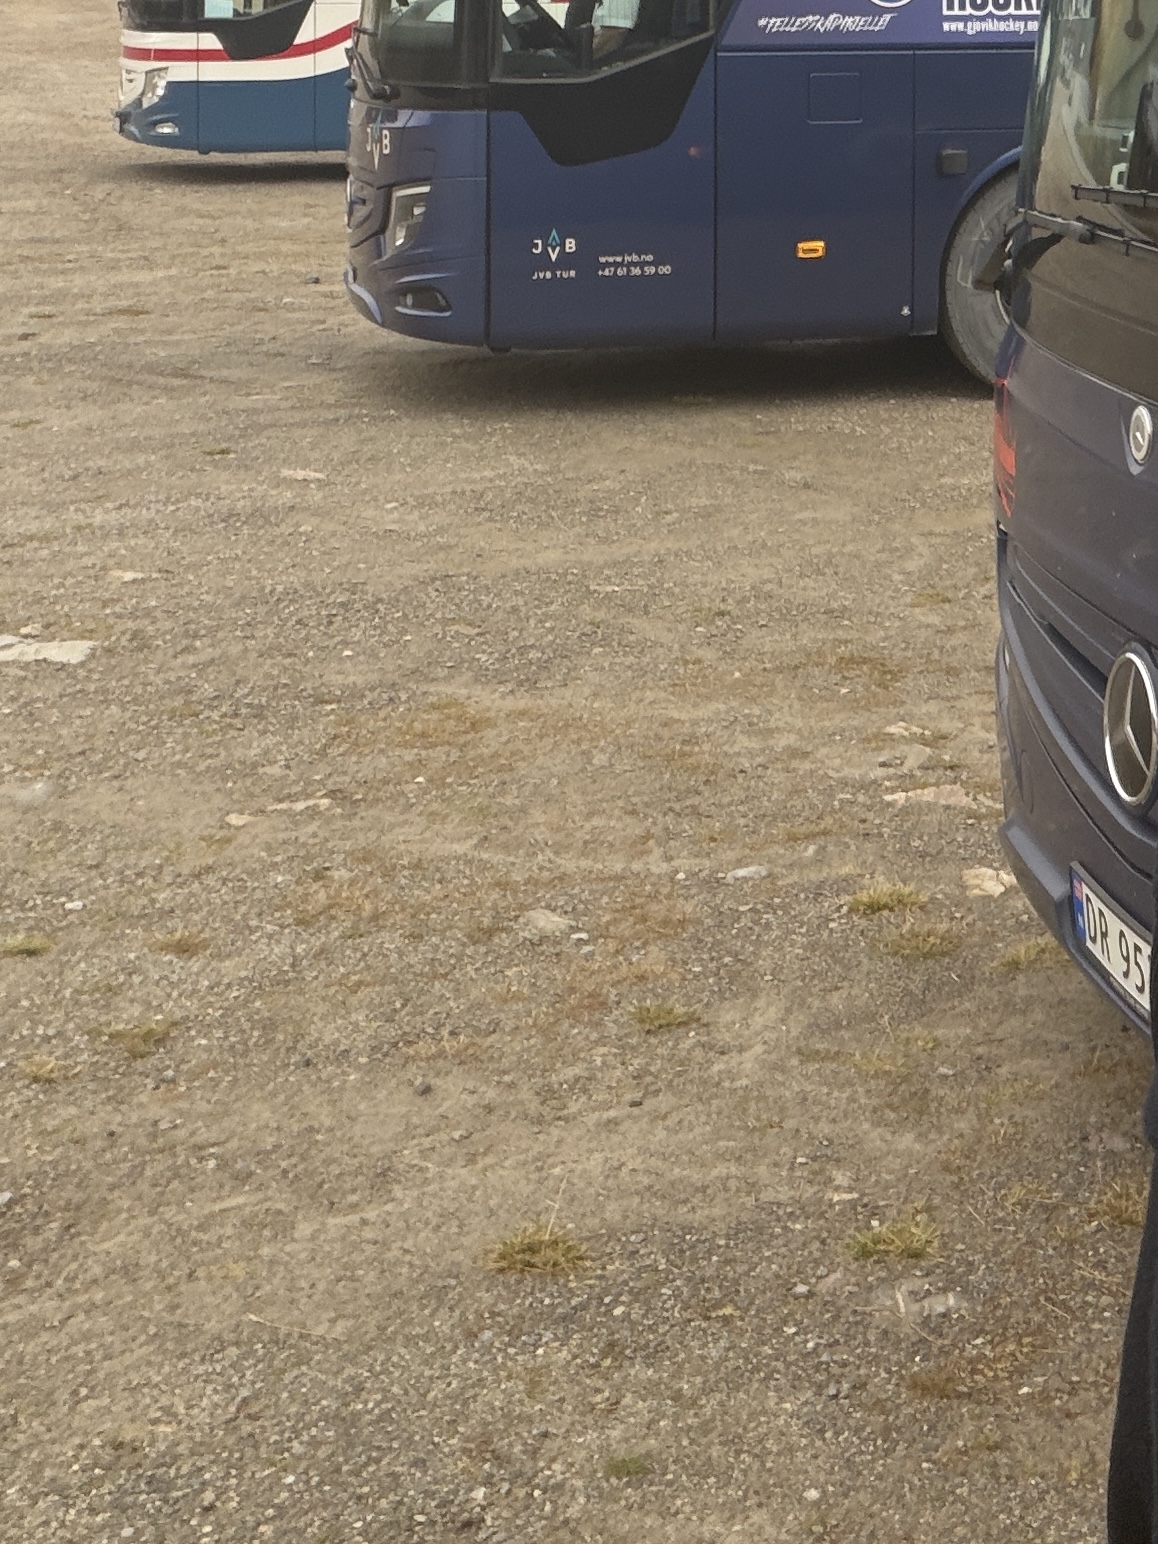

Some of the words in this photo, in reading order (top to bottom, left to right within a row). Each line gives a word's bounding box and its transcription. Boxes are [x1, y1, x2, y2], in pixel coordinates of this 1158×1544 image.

[617, 267, 627, 277] 61
[643, 266, 656, 276] 59
[657, 265, 672, 275] 00
[1085, 893, 1112, 965] DR
[1118, 928, 1151, 995] 95
